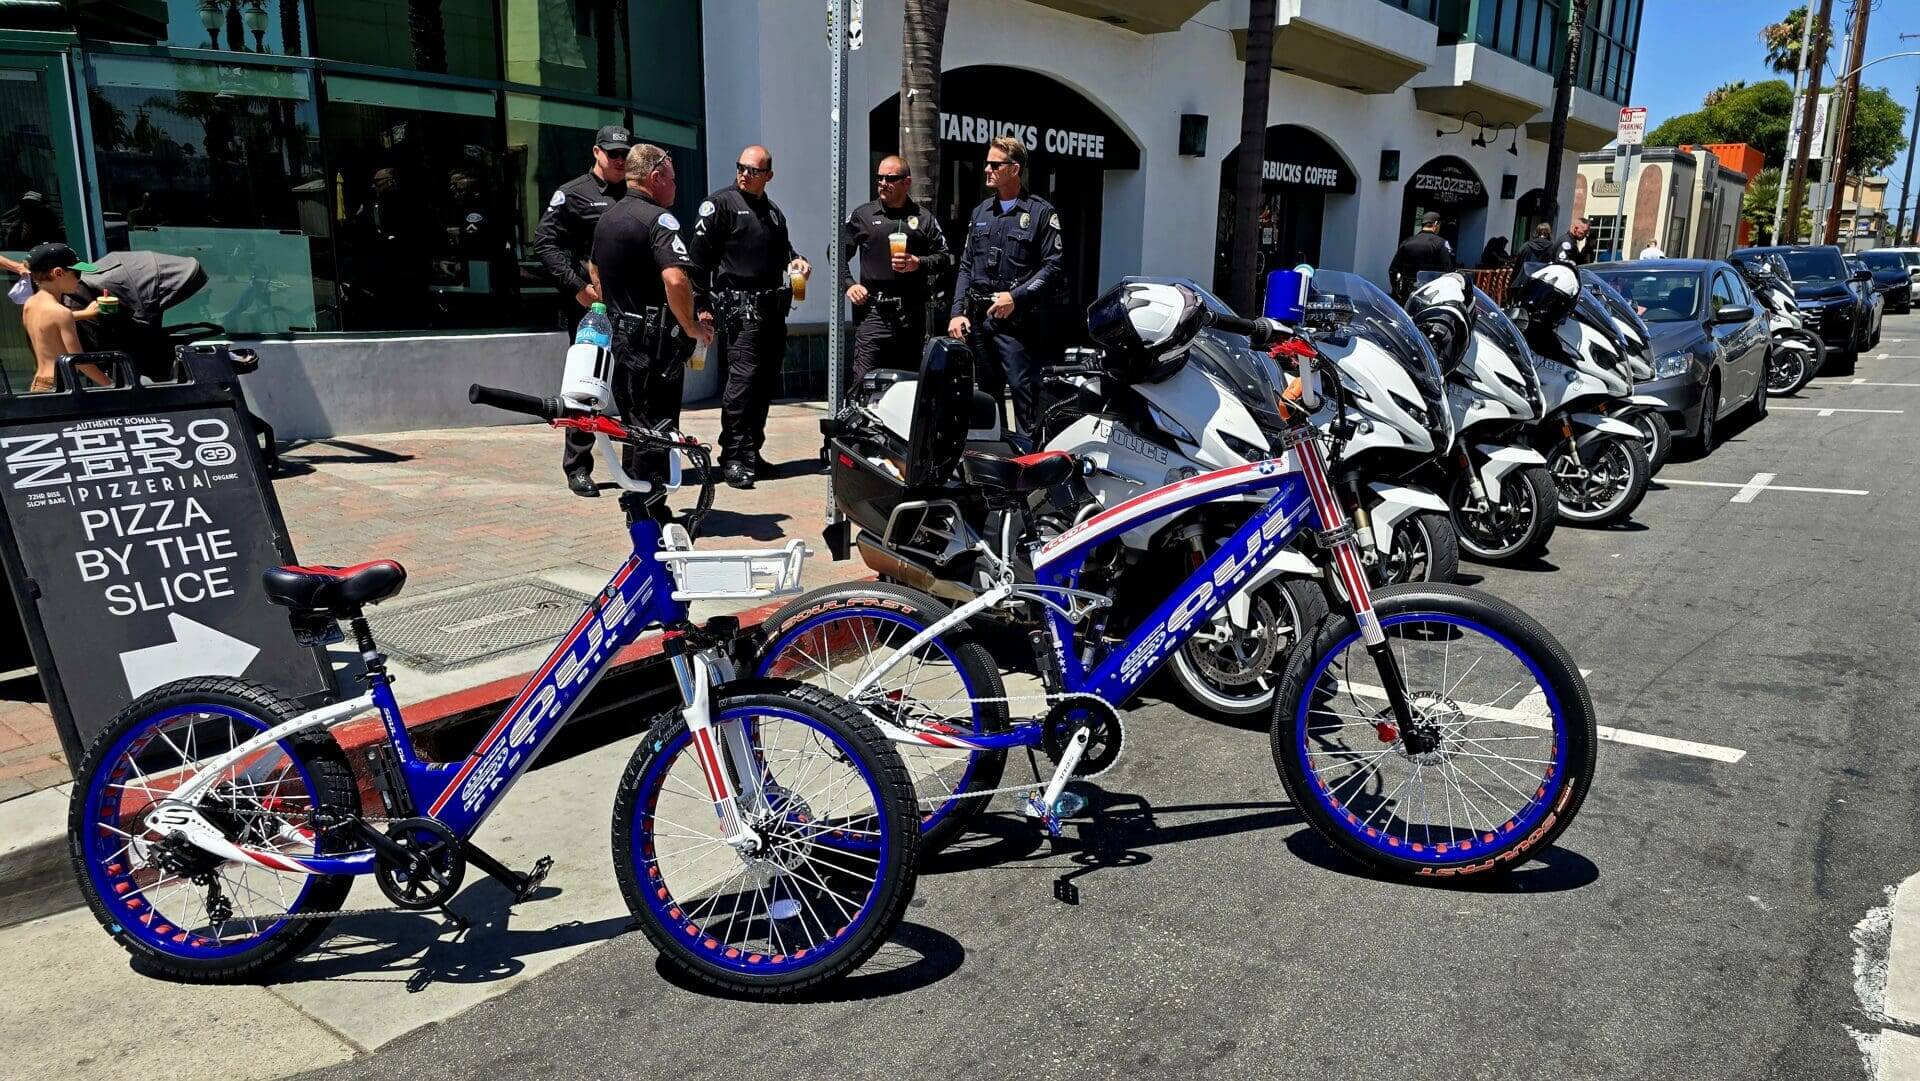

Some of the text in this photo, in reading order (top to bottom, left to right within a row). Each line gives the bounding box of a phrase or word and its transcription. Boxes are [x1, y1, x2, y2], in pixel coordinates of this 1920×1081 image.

[939, 112, 1104, 158] TARBUCKS COFFEE
[1620, 123, 1643, 131] PARKING
[1621, 113, 1631, 122] NO
[1263, 160, 1338, 186] RBUCKS COFFEE
[75, 416, 158, 431] AUTHENTIC ROMAN
[202, 449, 229, 460] 39
[1101, 422, 1168, 465] POLICE
[79, 473, 204, 502] PIZZERIA
[212, 472, 239, 481] ORGANIC
[26, 500, 46, 508] SLOW
[80, 496, 213, 542] PIZZA
[75, 528, 238, 583] BY THE
[104, 566, 235, 616] SLICE
[1121, 496, 1313, 683] SOUL
[781, 597, 918, 633] SOUL FAST
[462, 575, 654, 812] SOUL
[1415, 811, 1558, 876] SOUL FAST
